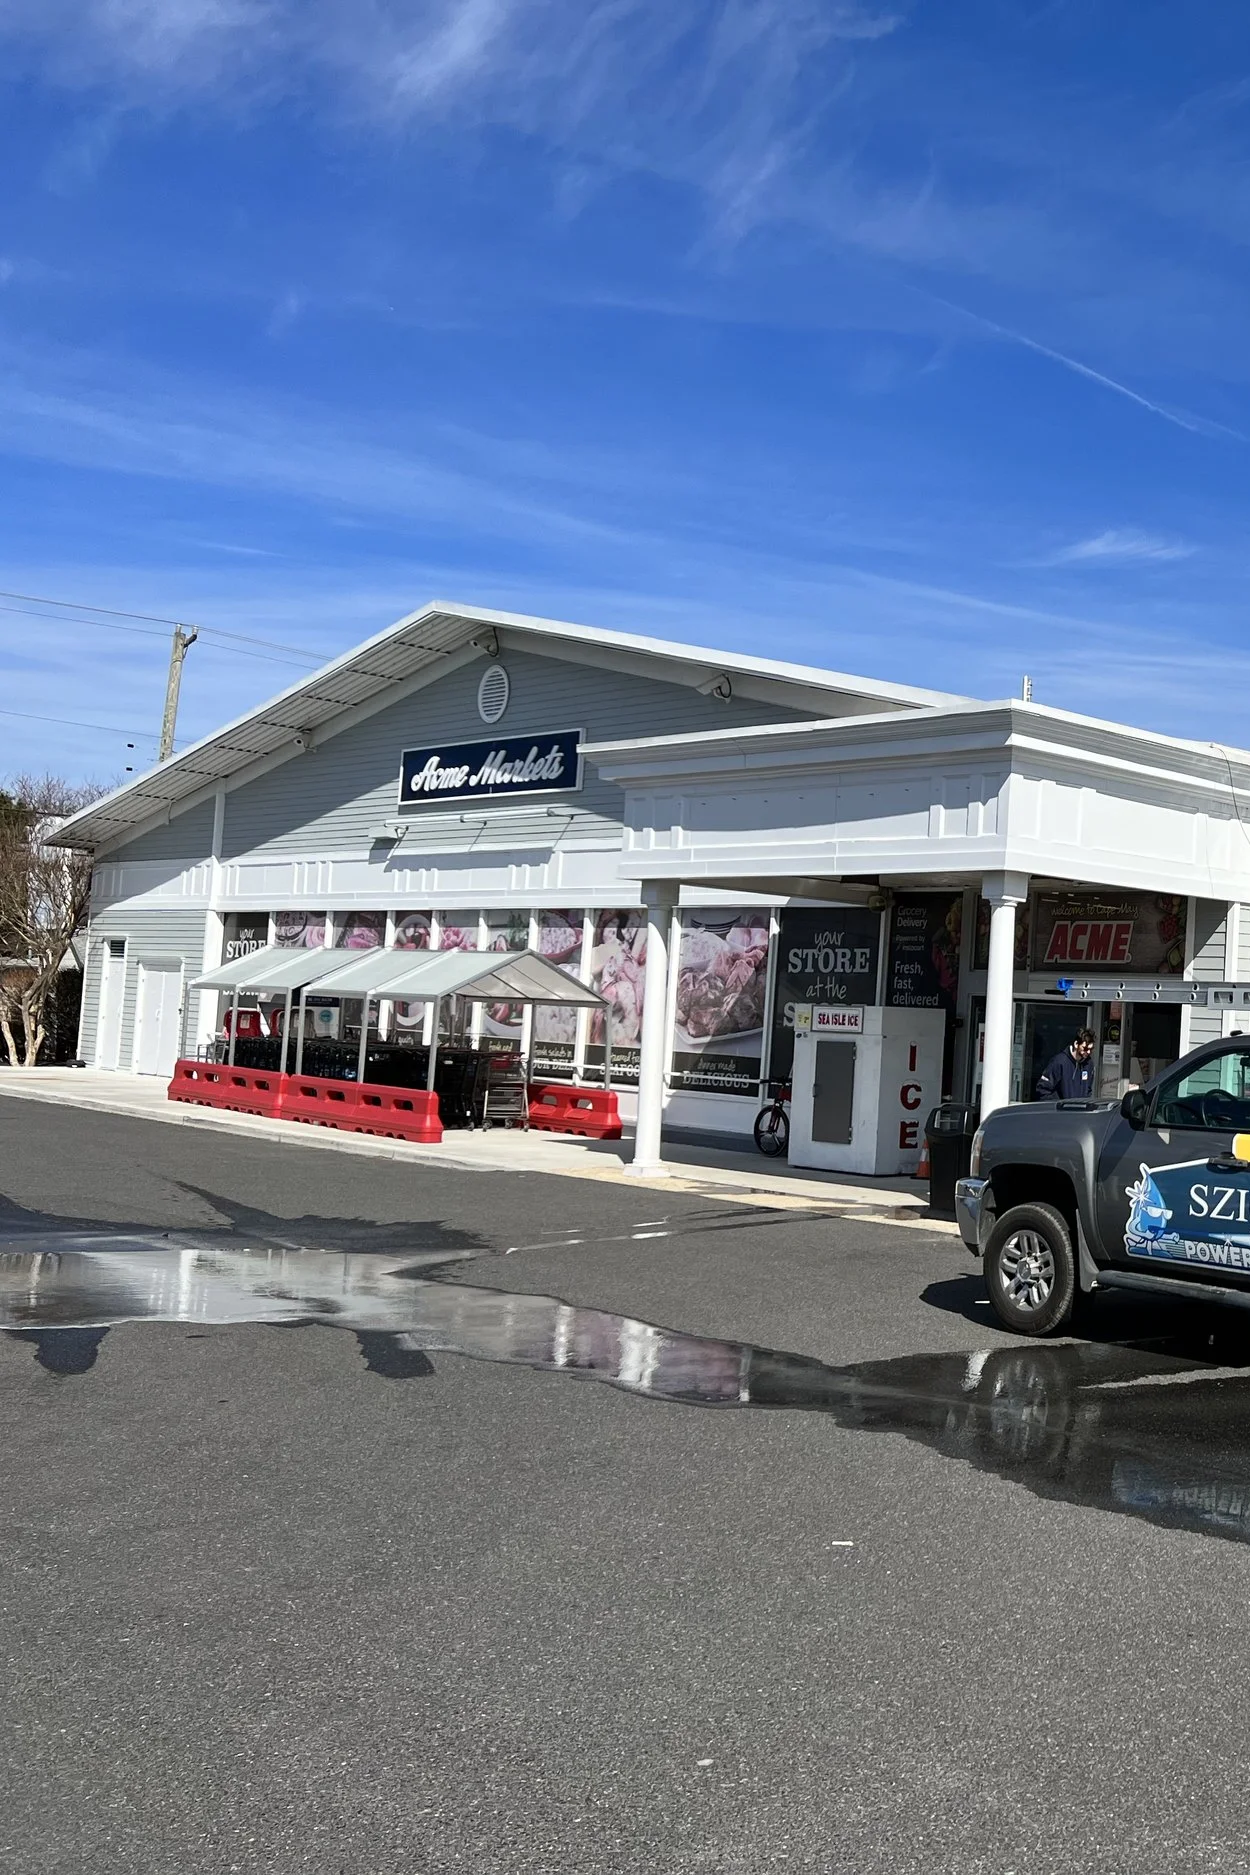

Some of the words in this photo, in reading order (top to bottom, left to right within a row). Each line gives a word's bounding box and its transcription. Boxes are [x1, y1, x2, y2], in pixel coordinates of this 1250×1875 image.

[411, 756, 470, 791] Acme
[469, 745, 564, 787] Markets
[897, 905, 927, 918] Grocery
[896, 917, 928, 930] Delivery
[814, 931, 845, 954] your
[1044, 920, 1134, 963] ACME
[787, 948, 871, 974] STORE
[894, 961, 924, 976] Fresh,
[805, 976, 824, 998] at
[824, 976, 847, 999] the
[893, 976, 914, 991] fast,
[892, 992, 939, 1006] delivered
[818, 1012, 830, 1025] SEA
[831, 1013, 846, 1026] ISLE
[847, 1014, 859, 1027] ICE
[682, 1070, 750, 1089] DELICIOUS
[899, 1042, 922, 1150] ICE
